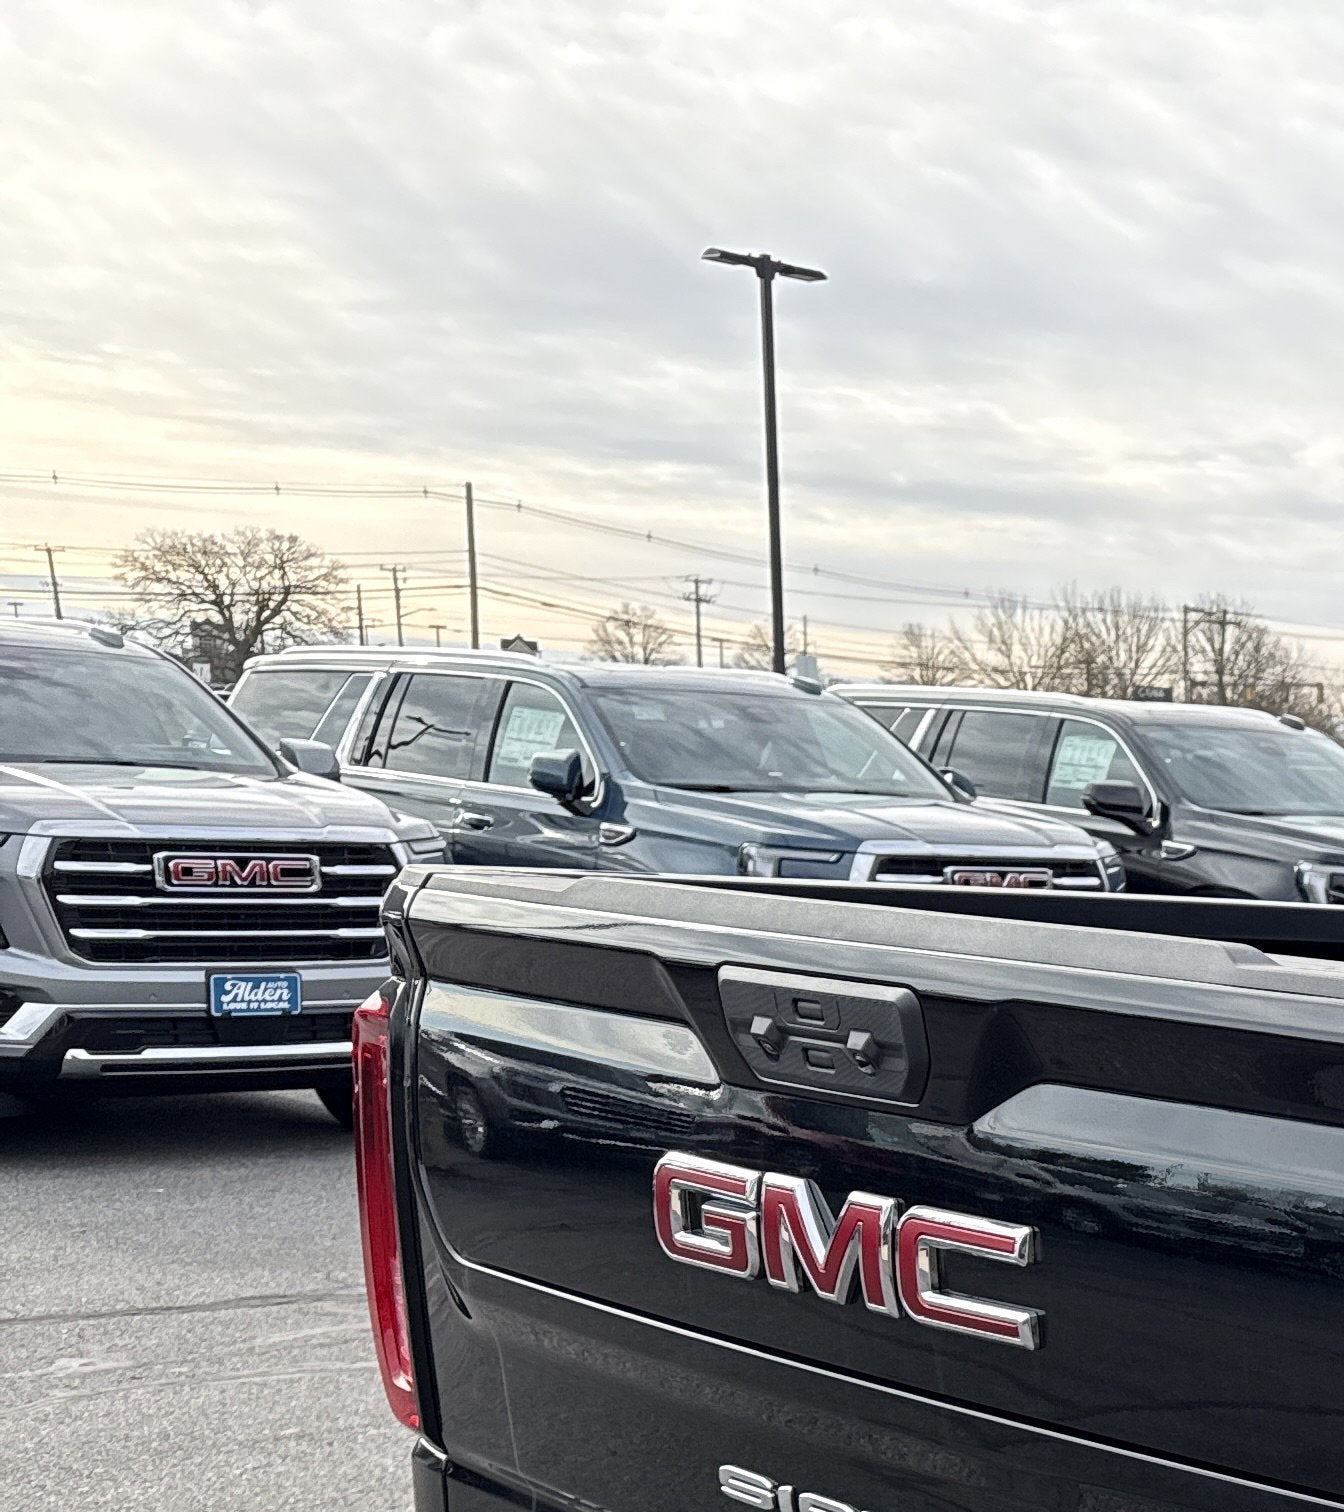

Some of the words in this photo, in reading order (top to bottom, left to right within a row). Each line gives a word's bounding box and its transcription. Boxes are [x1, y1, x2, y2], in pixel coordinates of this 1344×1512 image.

[168, 859, 314, 886] GMC
[221, 980, 292, 1003] Alden
[222, 1002, 248, 1010] LOVE
[260, 1001, 292, 1010] LOCAL
[653, 1150, 1044, 1351] GMC
